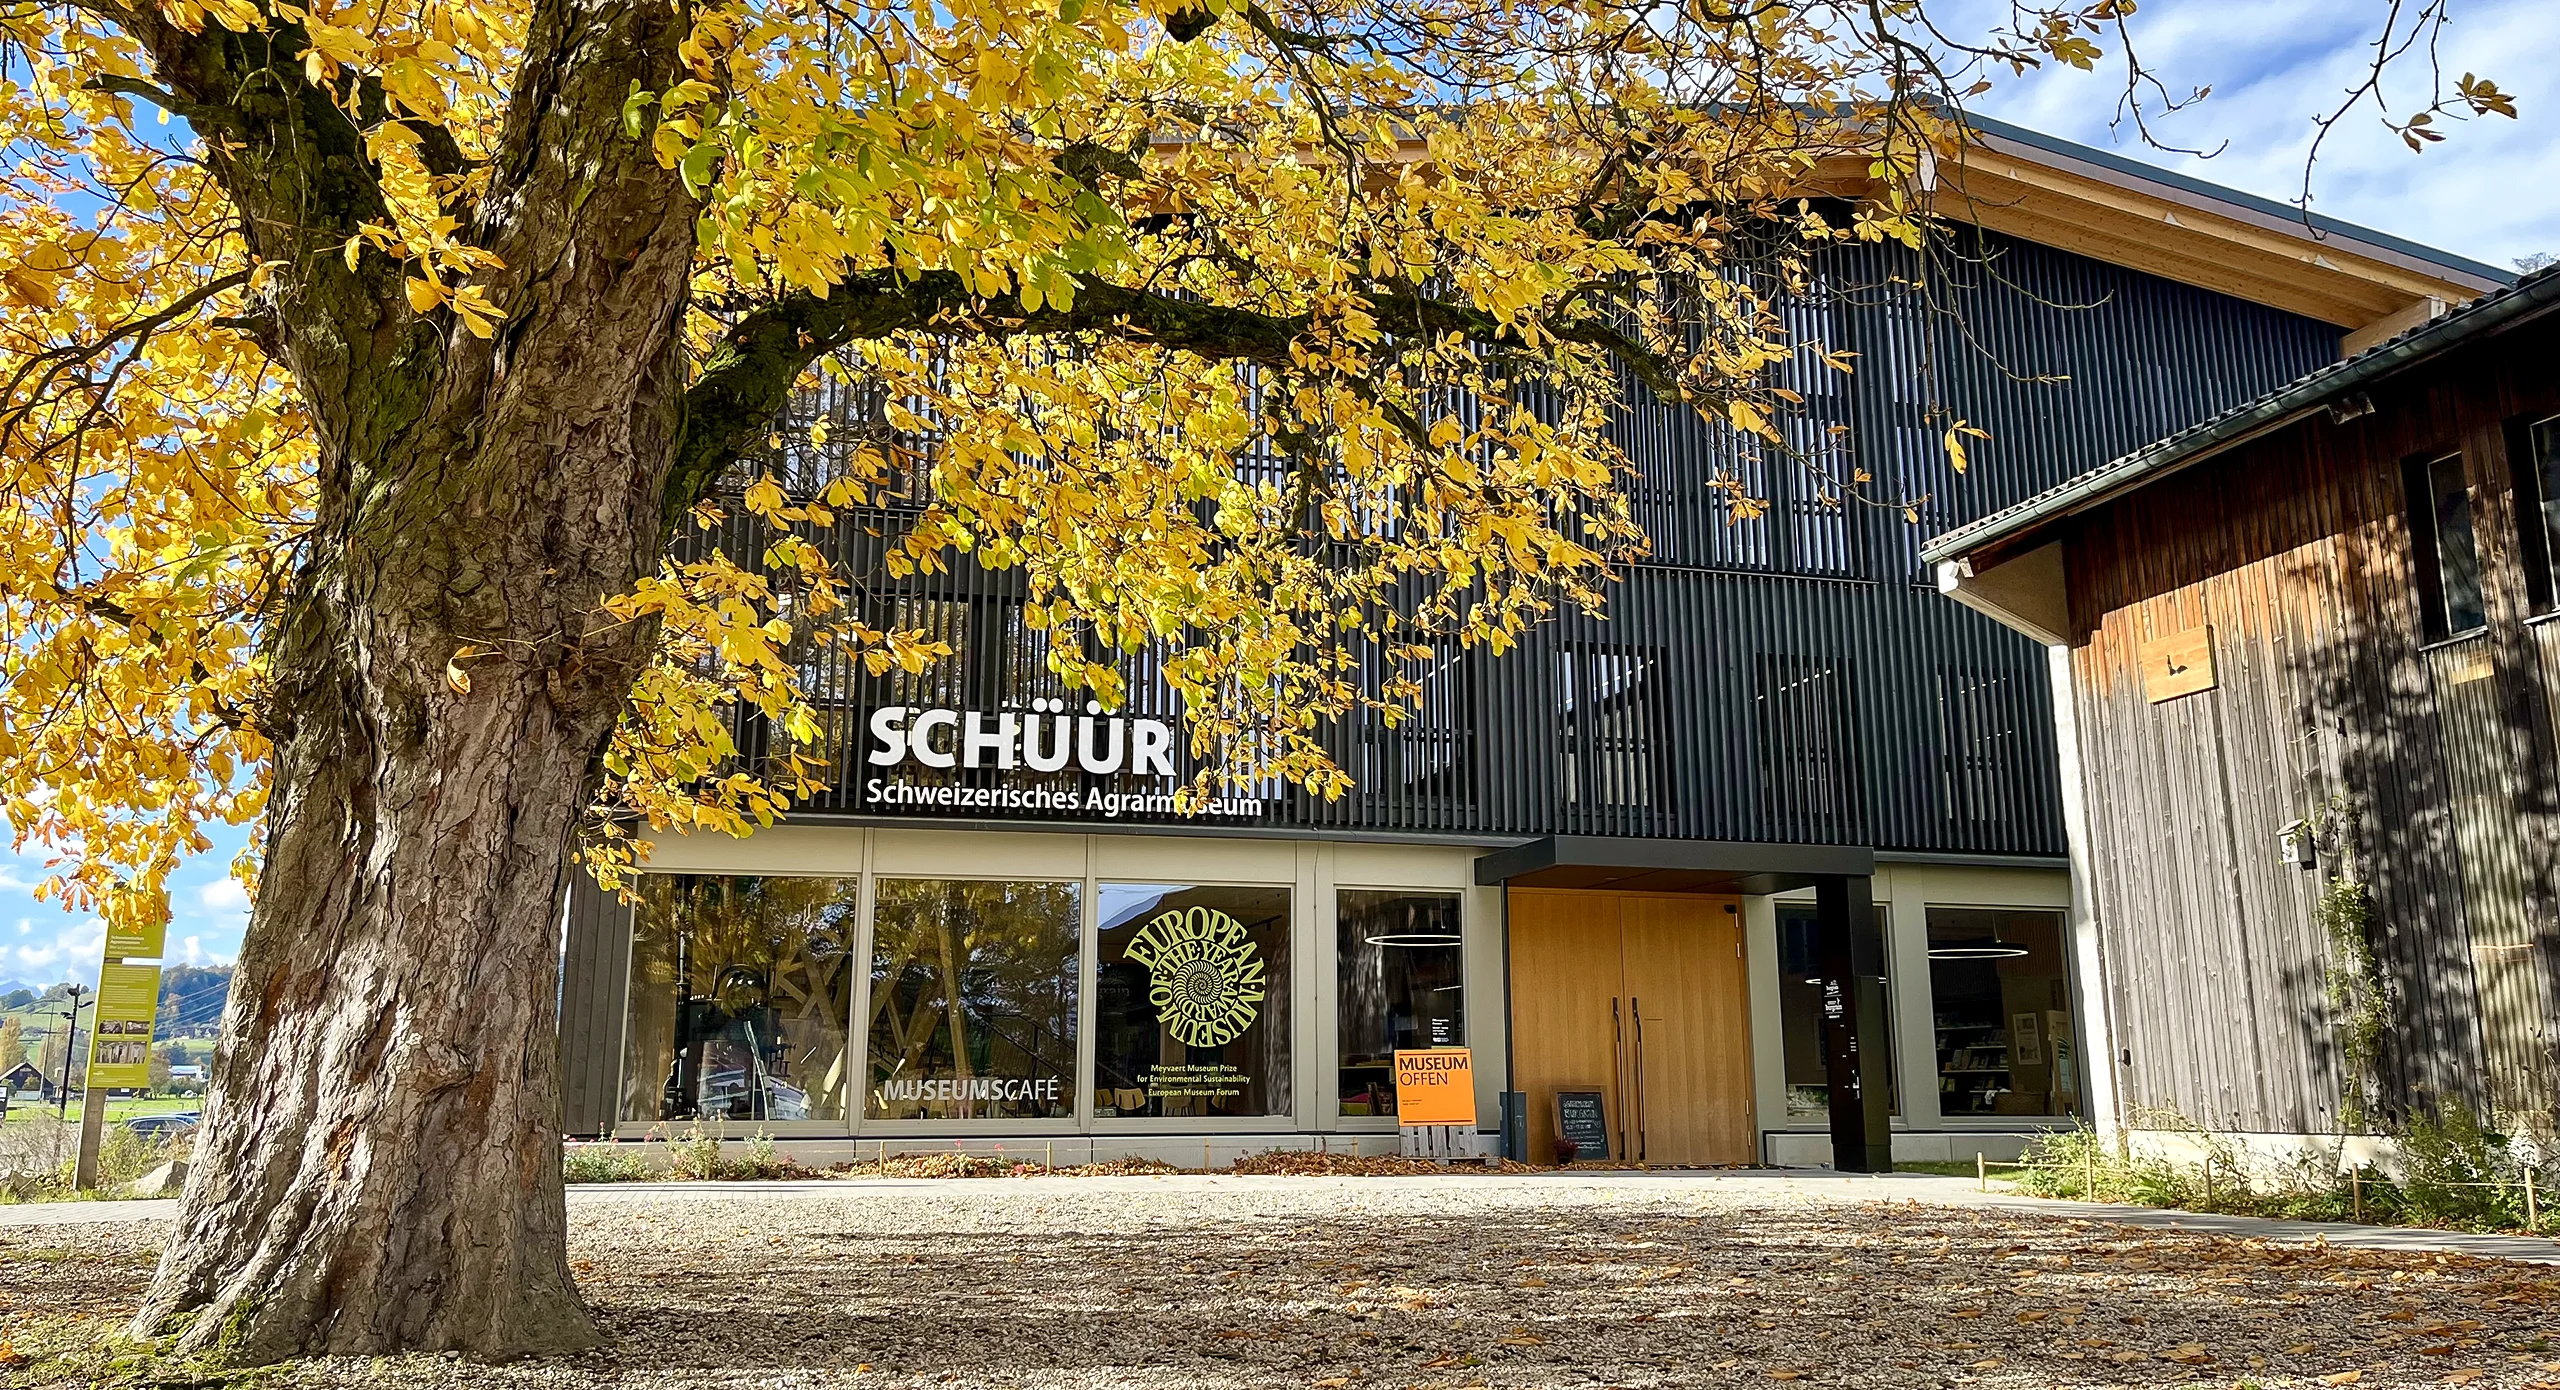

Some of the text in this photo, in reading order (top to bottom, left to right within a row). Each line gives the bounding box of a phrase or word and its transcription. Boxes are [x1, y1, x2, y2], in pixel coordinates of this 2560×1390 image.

[868, 697, 1177, 776] SCHÜÜR
[867, 778, 1079, 810] Schweizerisches
[1122, 905, 1266, 1048] EUROPEAN MUSEUM OF THE YEAR AWARD
[1150, 1064, 1238, 1074] Meyvaert Museum Prize
[1399, 1056, 1468, 1071] MUSEUM
[1137, 1074, 1251, 1084] for Environmental Sustainability
[1400, 1072, 1448, 1086] OFFEN
[883, 1075, 1059, 1101] MUSEUMSCAFÉ
[1148, 1088, 1182, 1098] European
[1183, 1088, 1215, 1096] Museum
